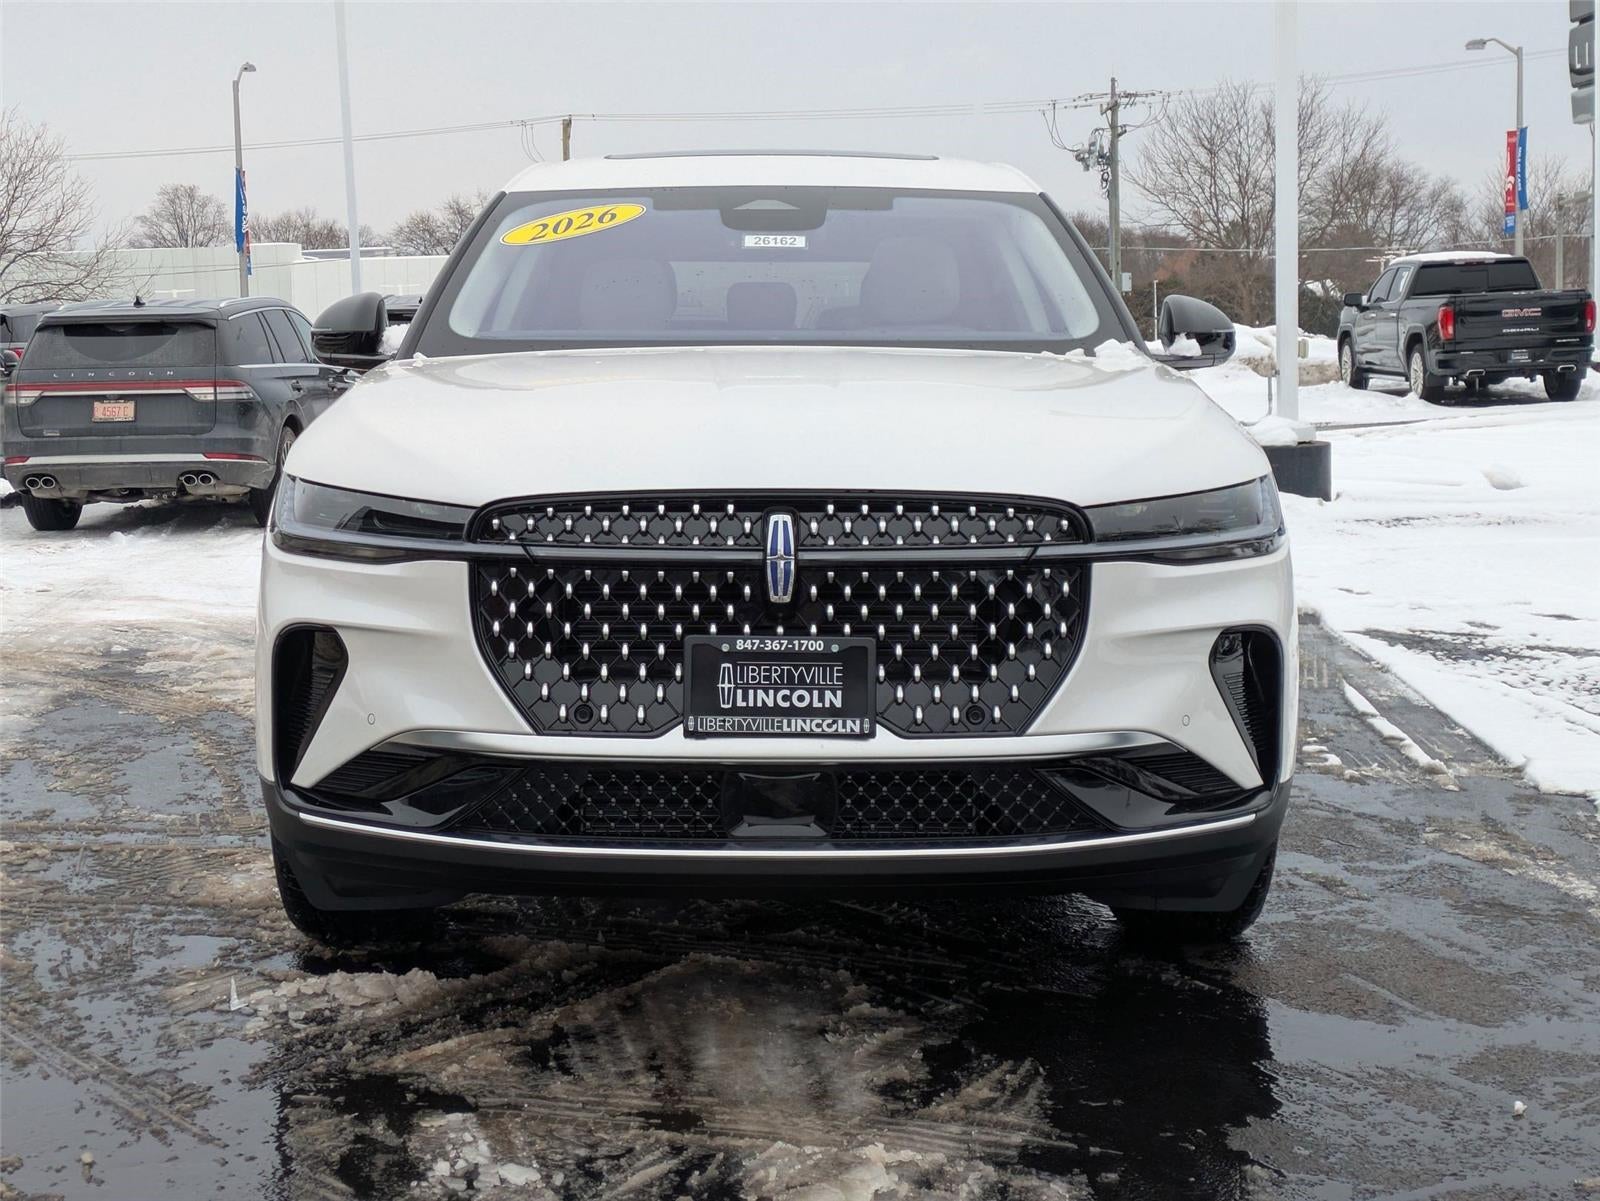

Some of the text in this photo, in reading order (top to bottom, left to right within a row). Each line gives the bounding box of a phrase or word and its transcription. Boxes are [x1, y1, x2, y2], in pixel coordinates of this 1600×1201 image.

[528, 206, 617, 242] 2026
[753, 235, 798, 246] 26162
[1502, 307, 1542, 318] GMC
[53, 370, 174, 378] LINCOLN
[101, 406, 121, 417] 4567
[736, 639, 824, 651] 847-367-1700
[737, 666, 843, 685] LIBERTYVILLE
[737, 689, 842, 708] LINCOLN
